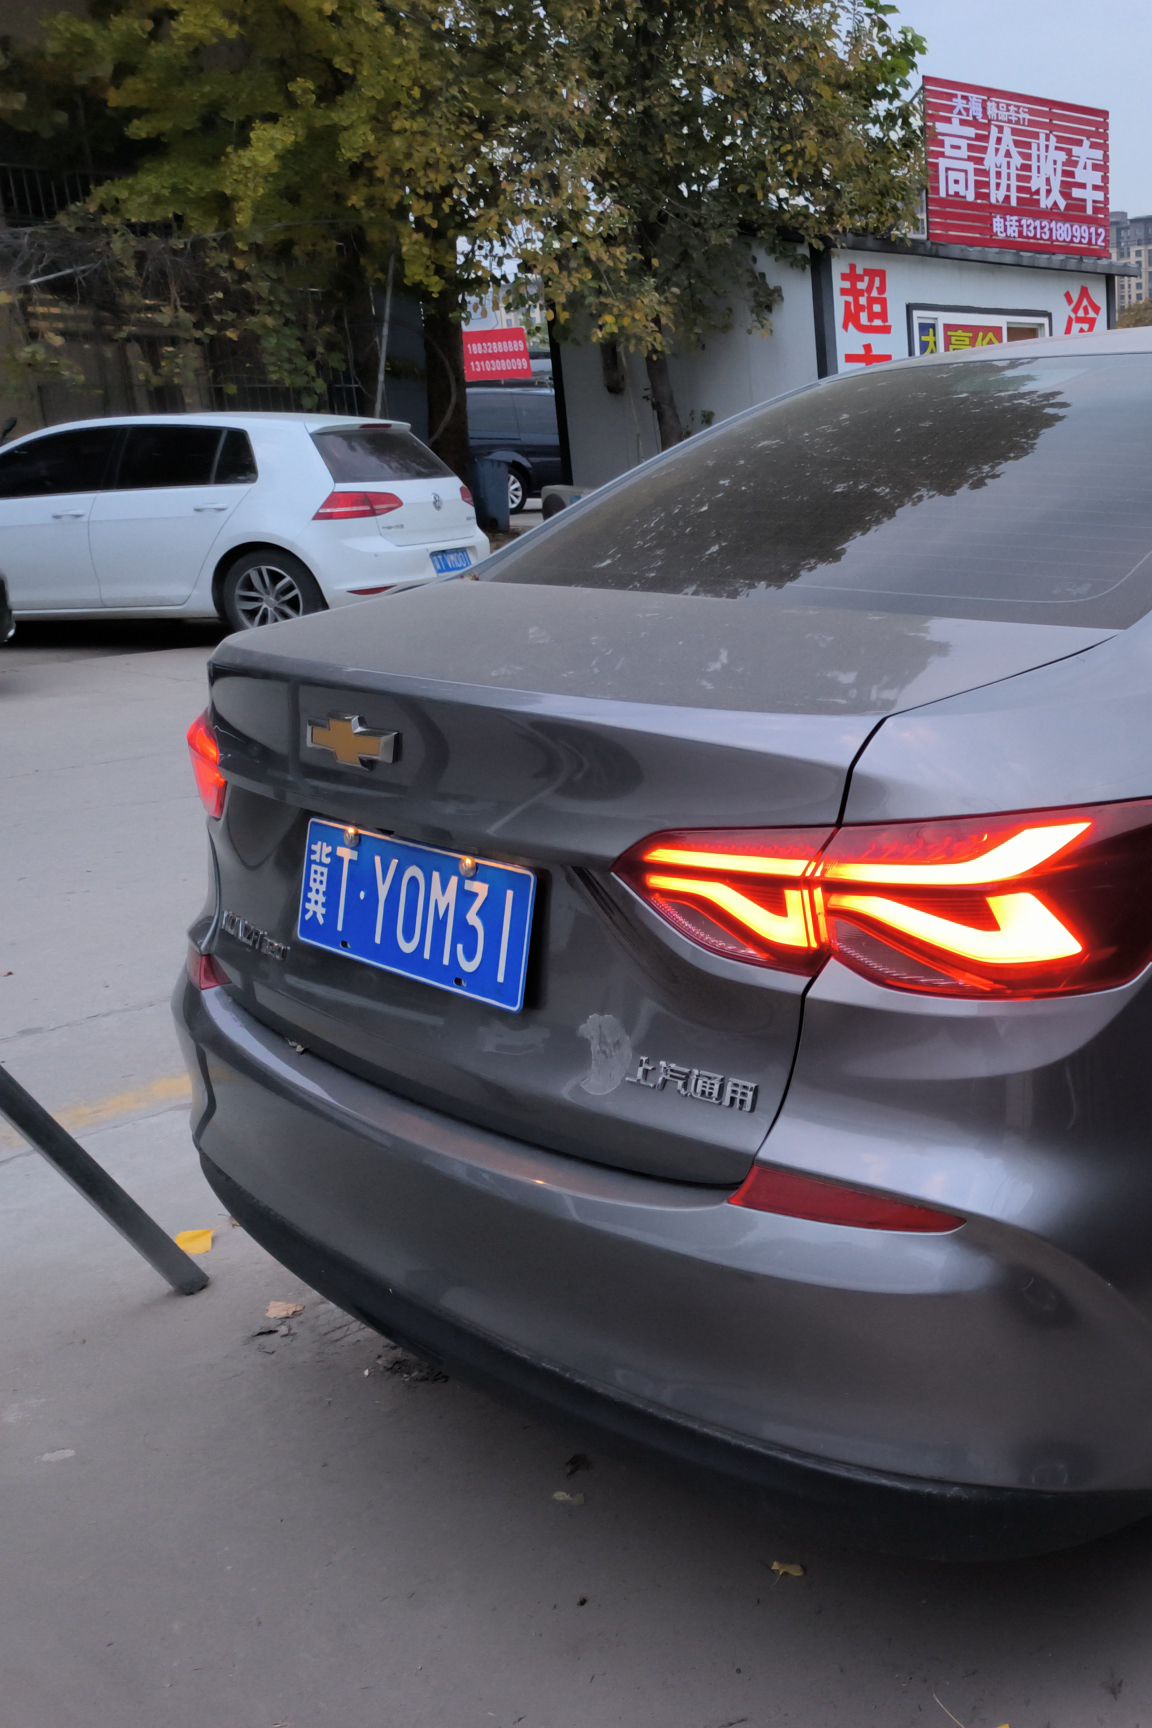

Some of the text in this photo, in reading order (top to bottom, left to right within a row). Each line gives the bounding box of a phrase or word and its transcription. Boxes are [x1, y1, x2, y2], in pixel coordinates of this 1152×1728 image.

[986, 100, 1030, 125] 精品车行
[934, 117, 1105, 215] 高价收车
[625, 1055, 759, 1113] 上汽通用
